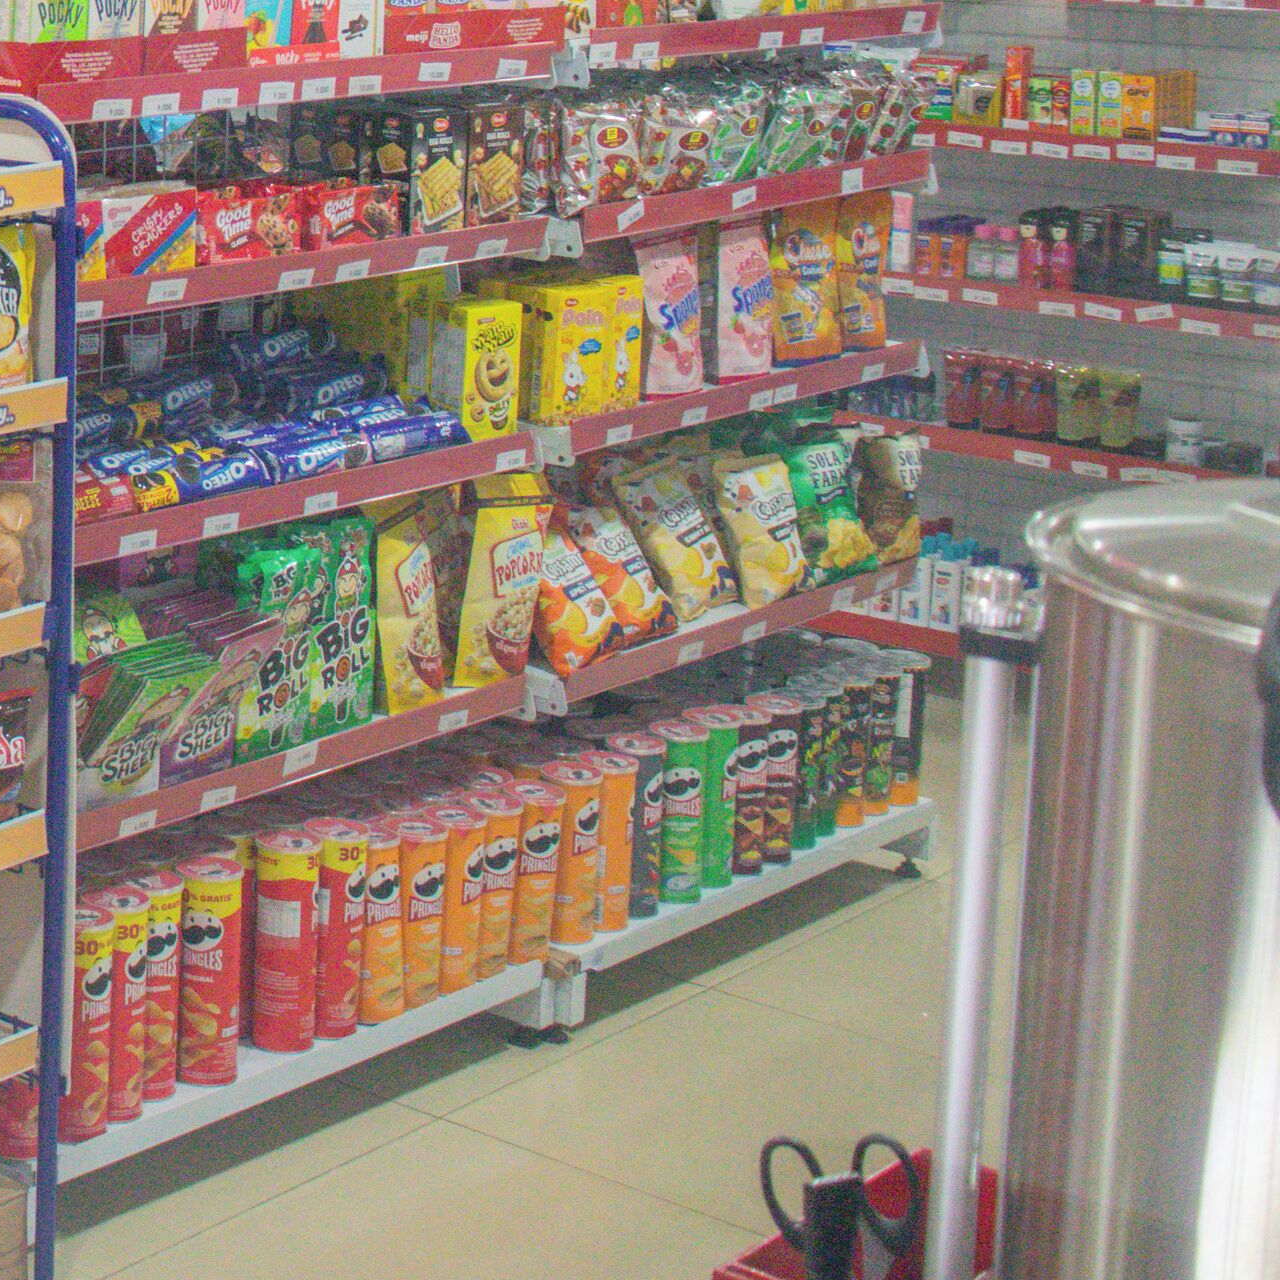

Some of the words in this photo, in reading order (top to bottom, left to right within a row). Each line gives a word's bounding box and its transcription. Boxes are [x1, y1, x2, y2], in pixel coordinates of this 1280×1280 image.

[405, 31, 429, 43] meiji
[222, 218, 251, 242] Time
[327, 206, 356, 225] Time
[263, 328, 308, 358] OREO
[163, 379, 215, 413] OREO
[320, 650, 370, 690] ROLL
[257, 677, 309, 717] ROLL
